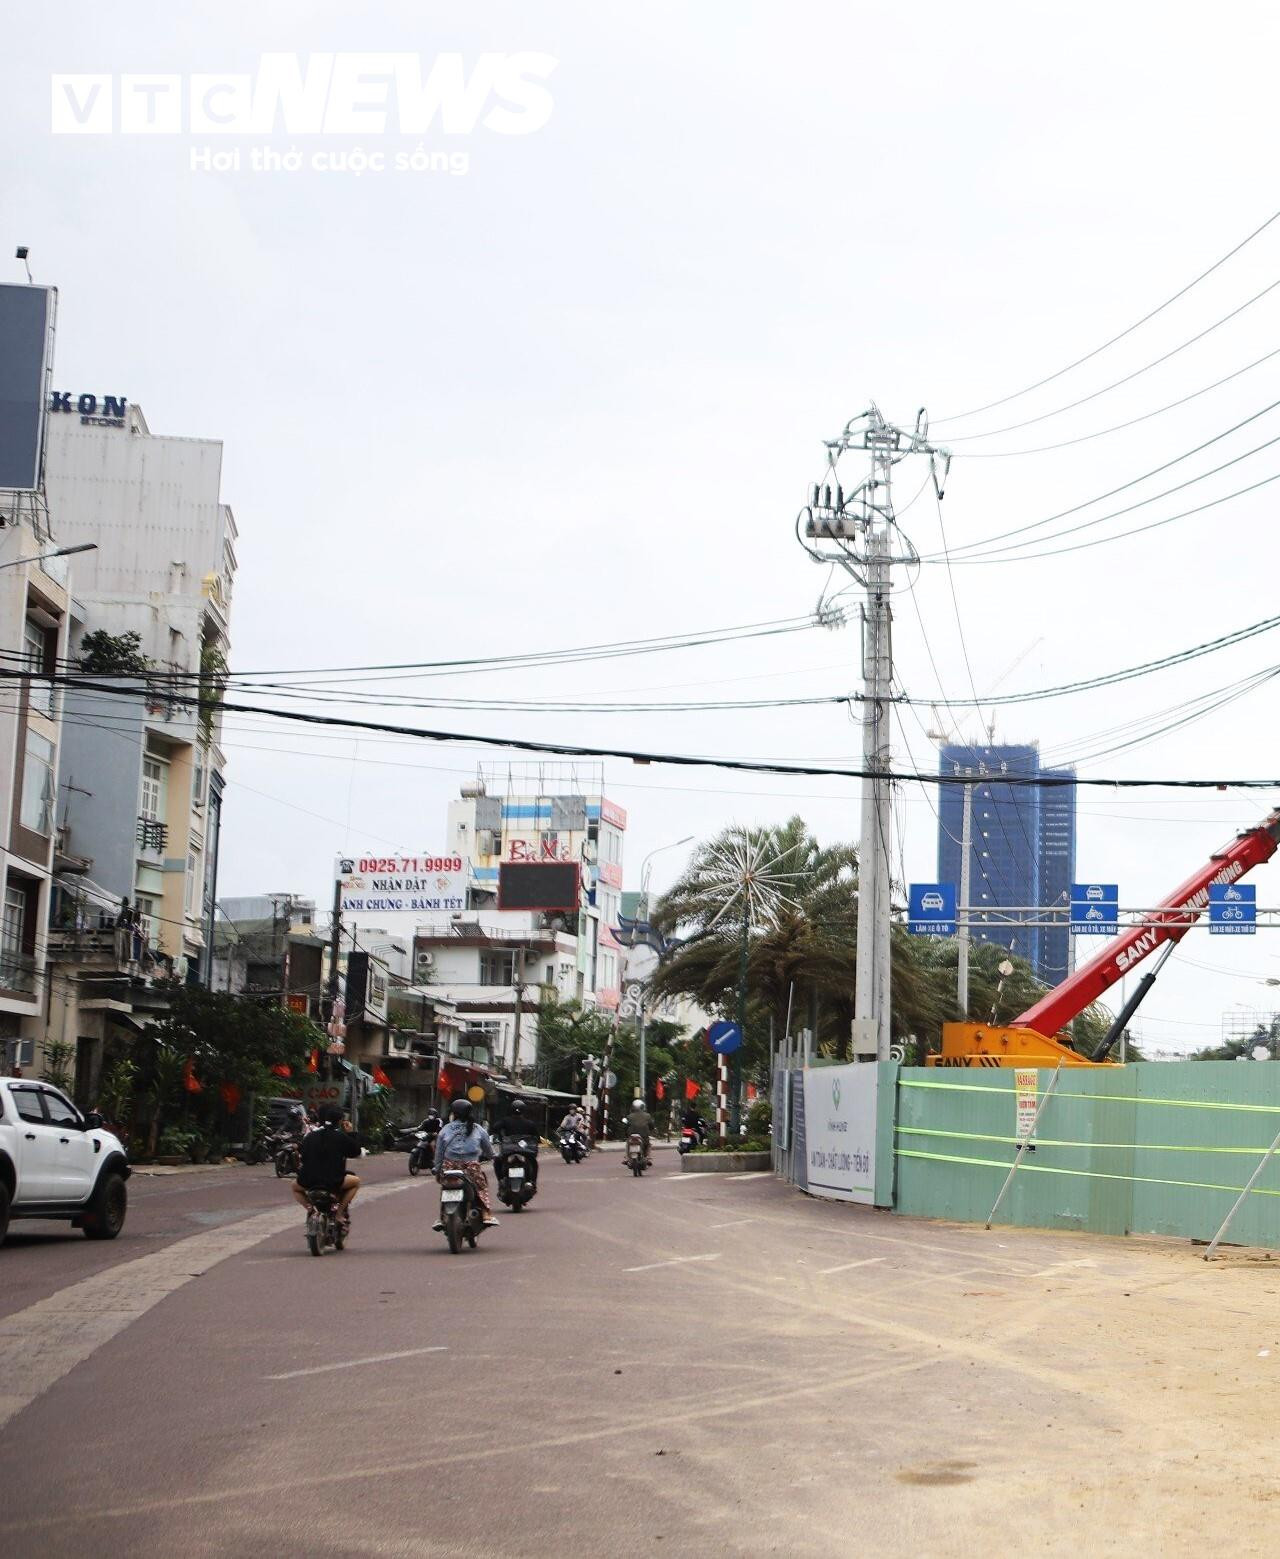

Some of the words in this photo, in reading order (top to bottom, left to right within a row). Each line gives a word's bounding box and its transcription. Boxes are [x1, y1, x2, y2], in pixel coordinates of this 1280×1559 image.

[359, 858, 461, 873] 0925.71.9999
[342, 896, 363, 909] ÁNH
[1115, 927, 1157, 972] SANY
